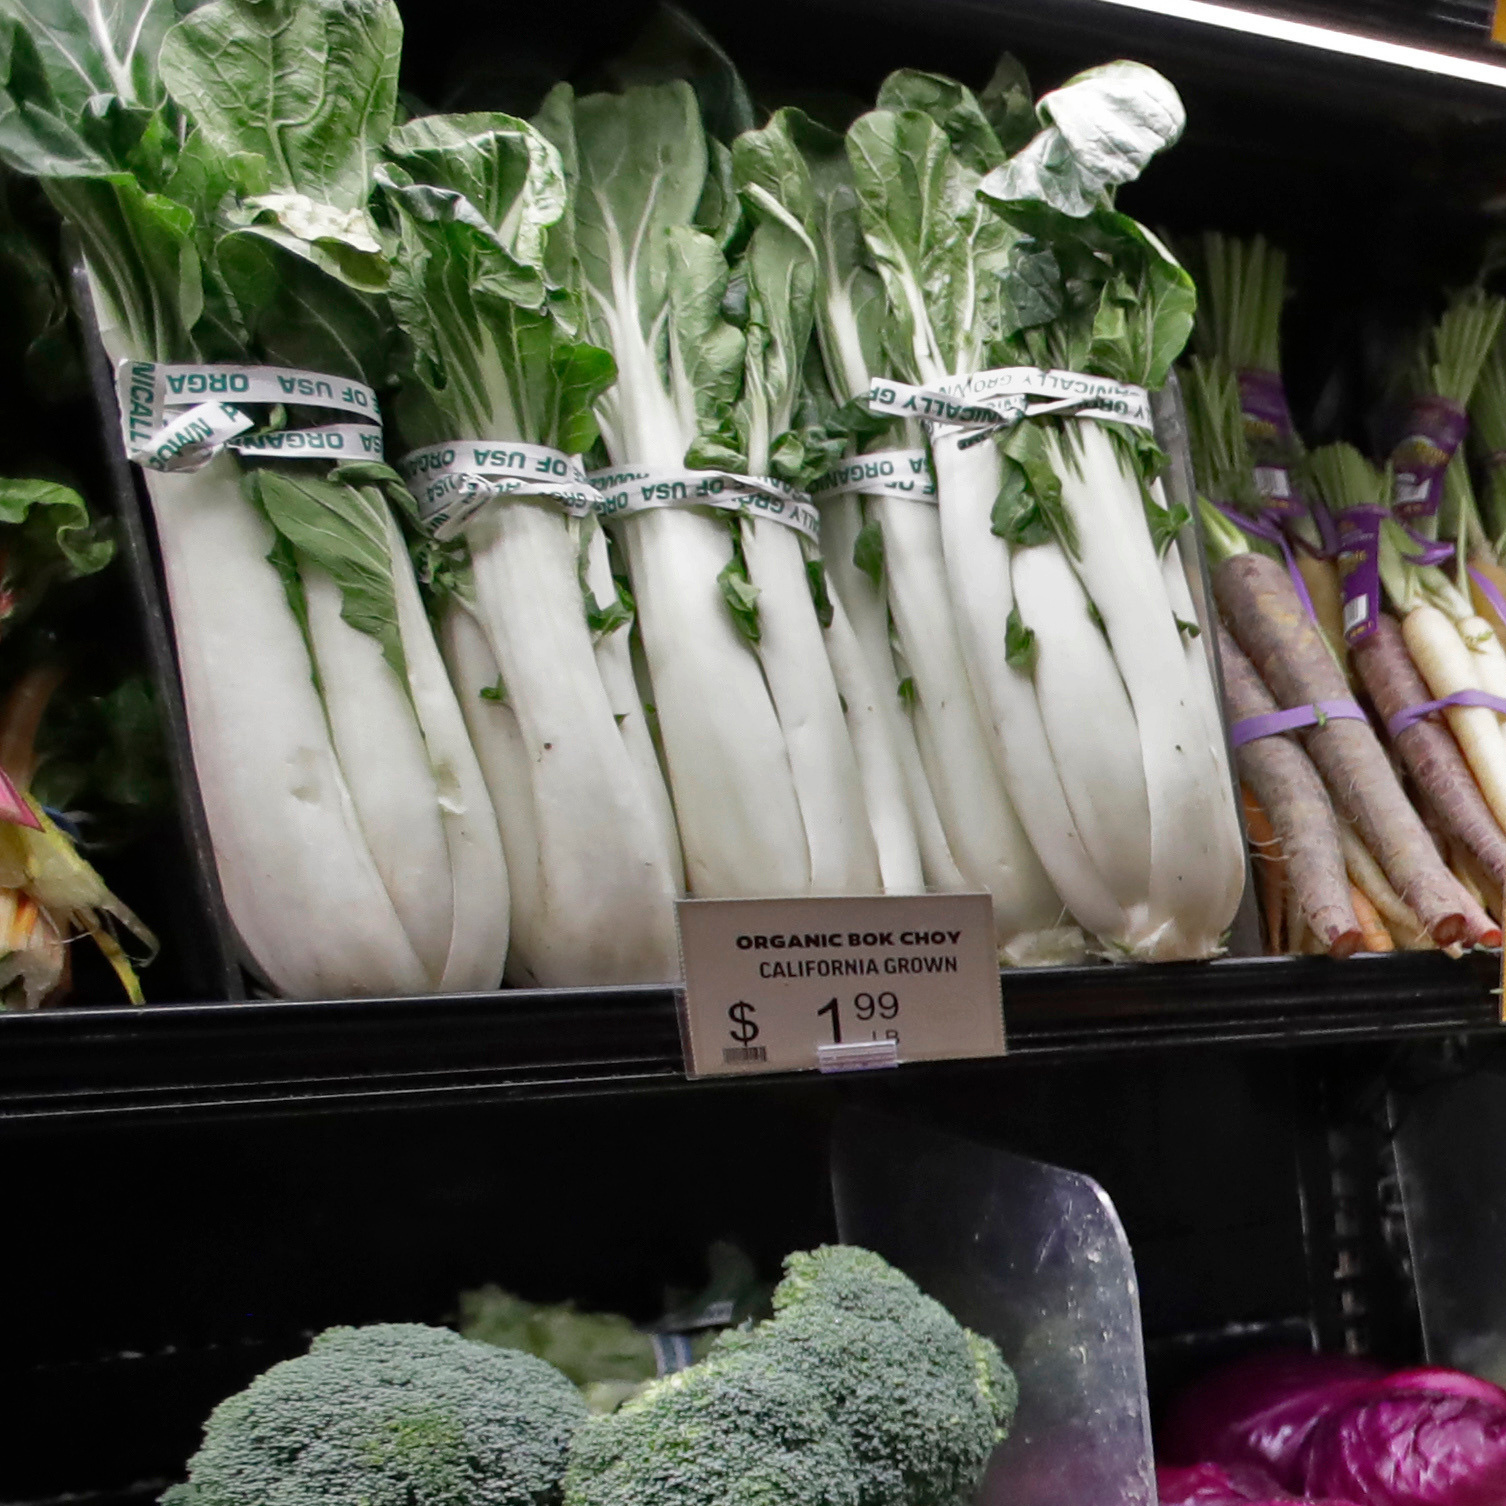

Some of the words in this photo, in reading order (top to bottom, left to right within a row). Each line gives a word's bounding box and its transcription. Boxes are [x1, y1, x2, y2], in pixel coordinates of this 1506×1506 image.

[277, 375, 333, 398] USA
[341, 387, 368, 407] OF
[129, 361, 156, 443] NICALL
[240, 432, 344, 450] ORGAN
[472, 448, 526, 469] USA
[535, 457, 568, 477] OF
[640, 482, 687, 501] USA
[735, 932, 843, 951] ORGANIC
[847, 931, 894, 948] BOK
[899, 929, 963, 946] CHOY
[758, 957, 879, 980] CALIFORNIA
[883, 955, 959, 975] GROWN
[727, 999, 760, 1047] $
